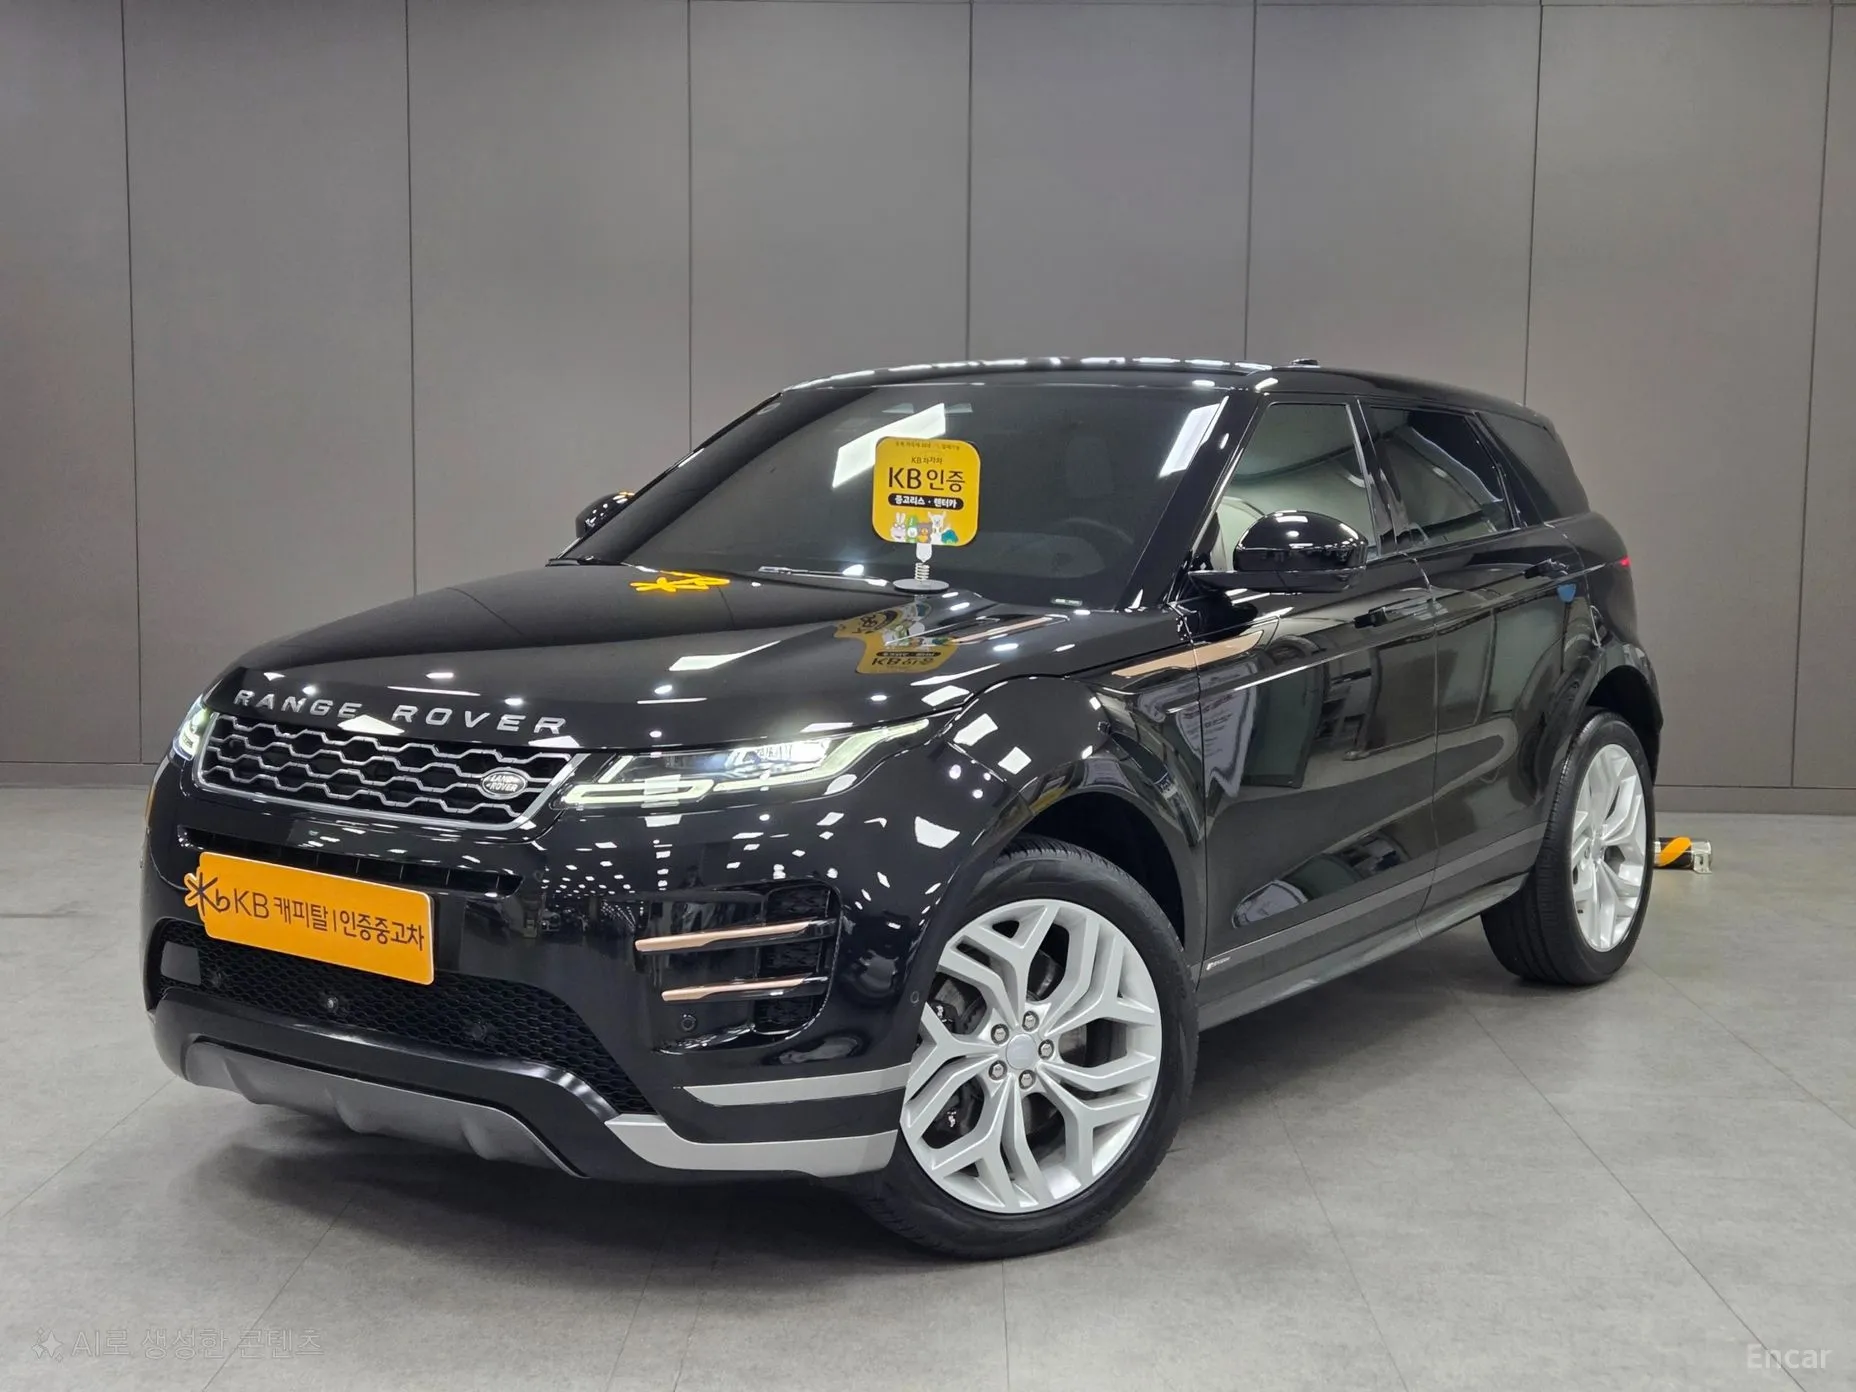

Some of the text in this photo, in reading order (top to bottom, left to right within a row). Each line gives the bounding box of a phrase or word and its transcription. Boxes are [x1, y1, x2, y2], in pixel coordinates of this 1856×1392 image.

[888, 467, 966, 493] KB 인증
[894, 495, 957, 508] 중고리스 렌터카
[233, 689, 566, 735] RANGE ROVER
[489, 783, 518, 792] ROVER
[233, 887, 425, 952] KB 캐피탈 인증중고차
